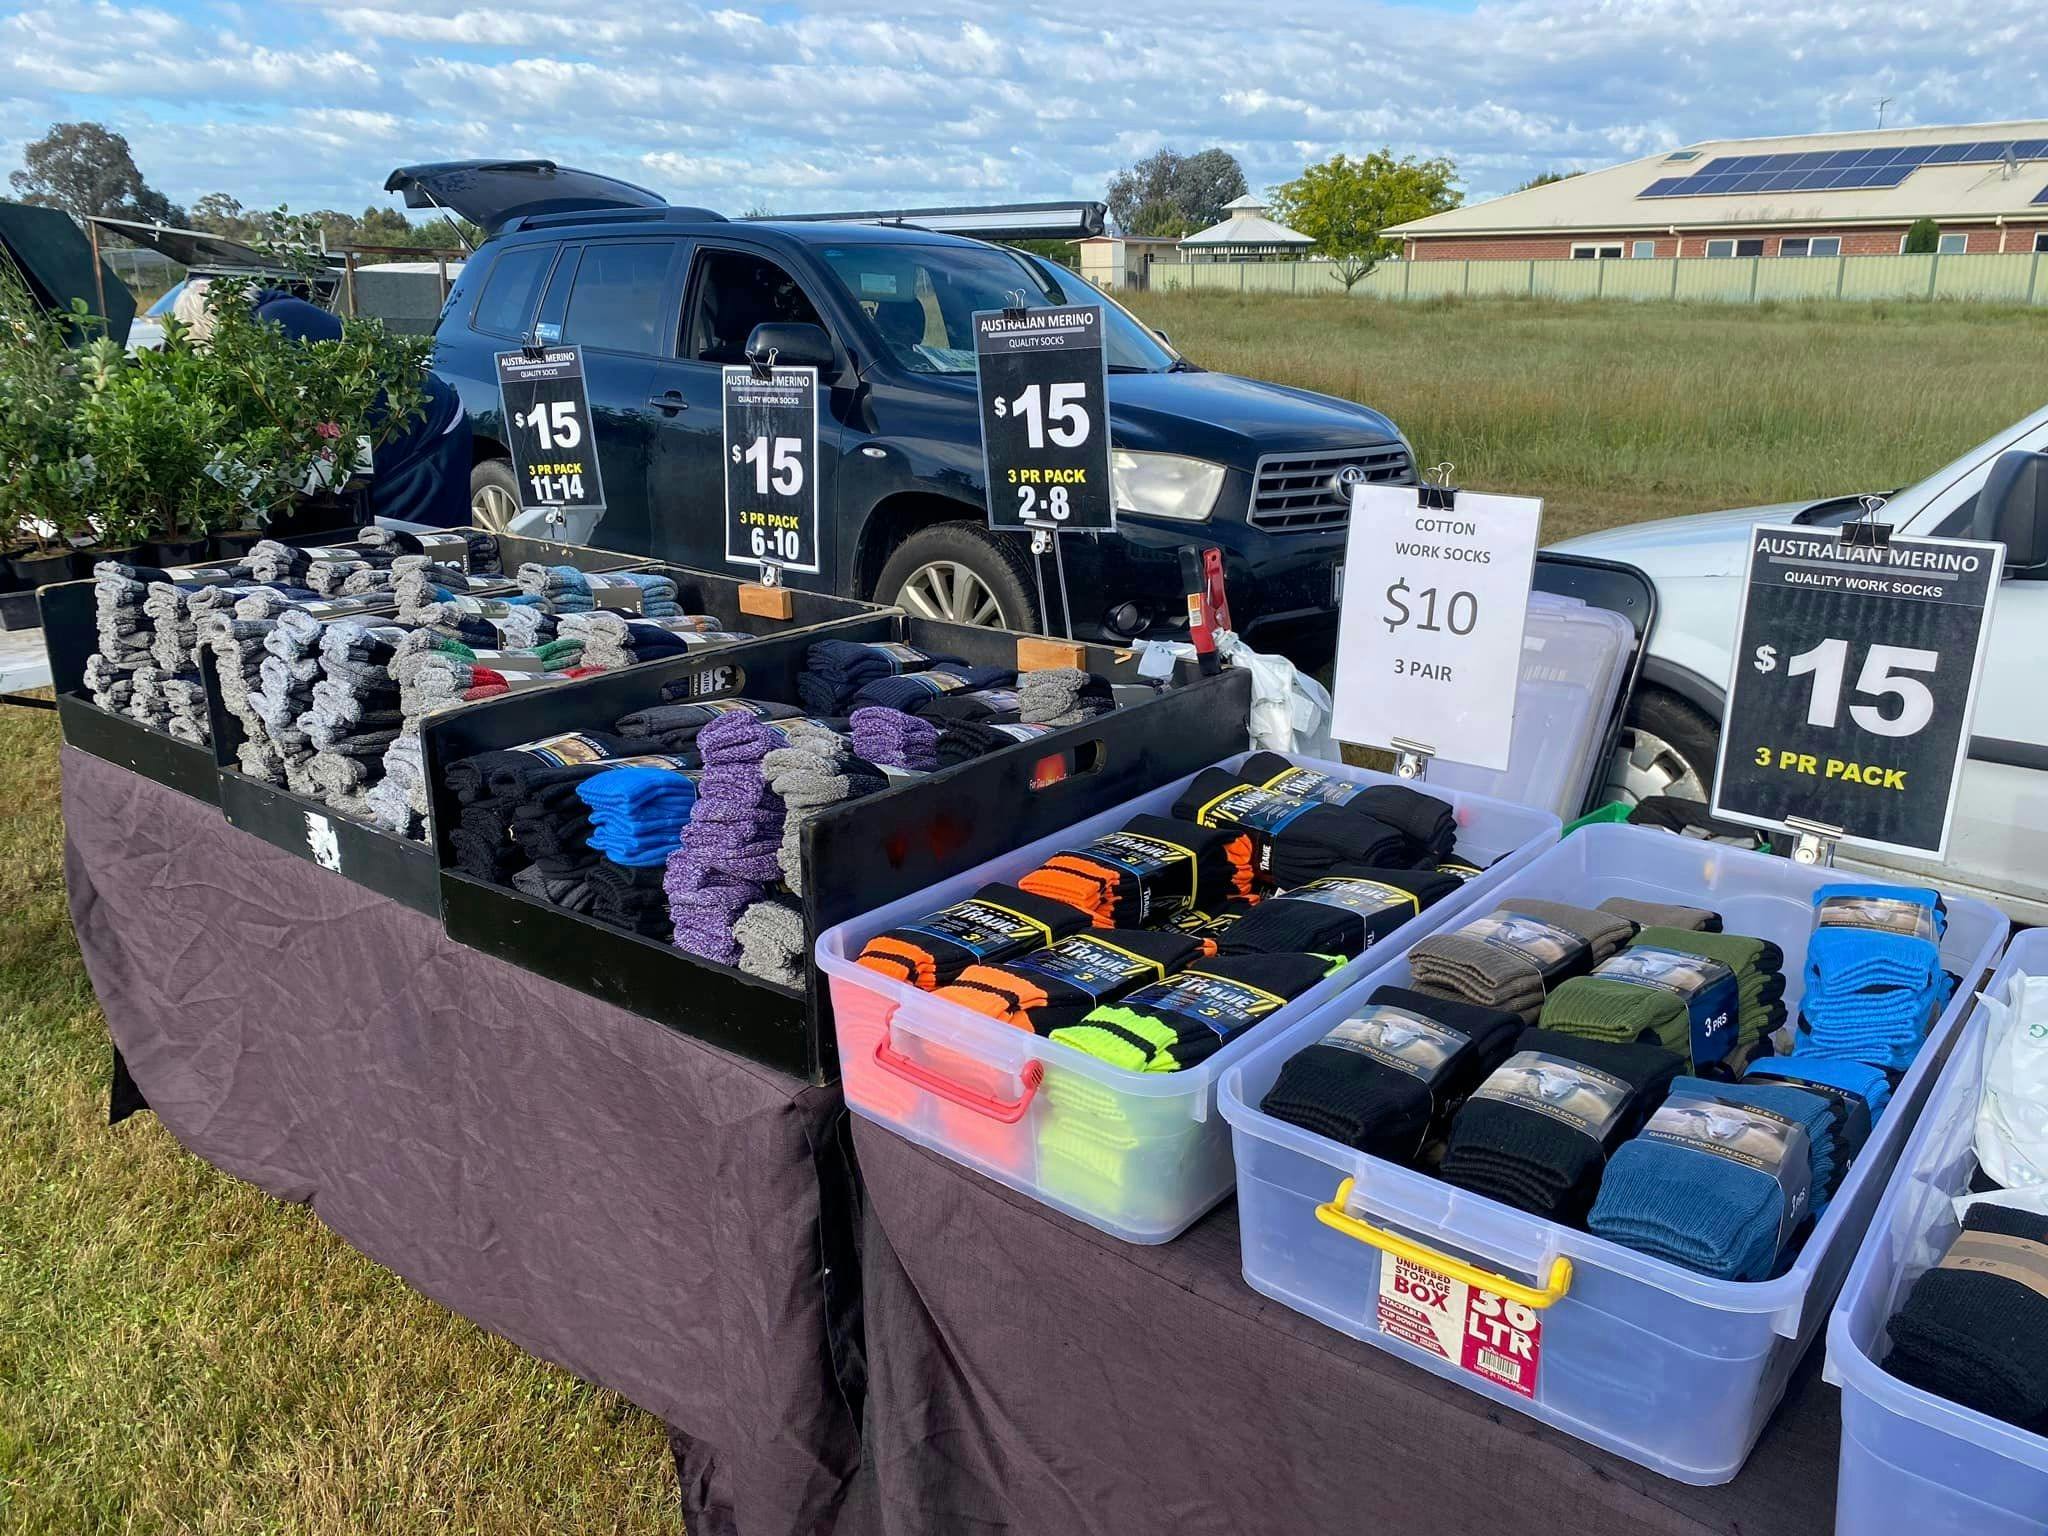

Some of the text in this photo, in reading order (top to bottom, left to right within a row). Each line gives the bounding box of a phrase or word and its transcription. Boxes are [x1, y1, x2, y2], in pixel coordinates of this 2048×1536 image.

[981, 312, 1094, 332] AUSTRALIAN MERINO
[1008, 335, 1064, 348] QUALITY SOCKS
[501, 351, 575, 366] AUSTRA MERINO
[520, 368, 558, 378] QUALITY SOCKS
[776, 376, 809, 387] MERINO
[738, 395, 761, 404] QUALITY
[779, 397, 799, 405] SOCKS
[515, 401, 581, 450] $15
[994, 382, 1090, 448] $15
[528, 463, 583, 476] 3 PR PACK
[732, 436, 804, 496] $15
[1008, 469, 1087, 483] 3 PR PACK
[530, 474, 584, 500] 11-14
[1017, 485, 1070, 520] 2-8
[740, 510, 799, 529] 3 PR PACK
[1415, 518, 1476, 536] COTTON
[751, 527, 800, 560] 6-10
[1395, 541, 1491, 564] WORK SOCKS
[1757, 537, 1979, 572] AUSTRALIAN MERINO
[1784, 571, 1943, 598] QUALITY WORK SOCKS
[1383, 577, 1478, 636] $10
[1393, 659, 1452, 682] 3 PAIR
[1754, 638, 1939, 737] $15
[1755, 747, 1907, 791] 3 PR PACK
[1260, 843, 1271, 871] TRADIE
[954, 903, 1020, 933] TRADIE
[1058, 940, 1130, 973] TRADIE
[1176, 976, 1254, 1008] TRADIE
[1705, 1012, 1727, 1037] 3 PRS
[1743, 1104, 1785, 1122] SIZE 6-11
[1648, 1131, 1687, 1143] QUALITY
[1687, 1138, 1732, 1155] WOOLLEN
[1732, 1150, 1764, 1165] SOCKS
[1395, 1265, 1451, 1294] STORAGE
[1396, 1256, 1451, 1284] UNDERBED
[1394, 1274, 1448, 1313] BOX
[1380, 1296, 1422, 1319] STACKABLE
[1381, 1308, 1397, 1320] CLIP
[1396, 1314, 1418, 1329] DOWN
[1469, 1311, 1534, 1361] LTR
